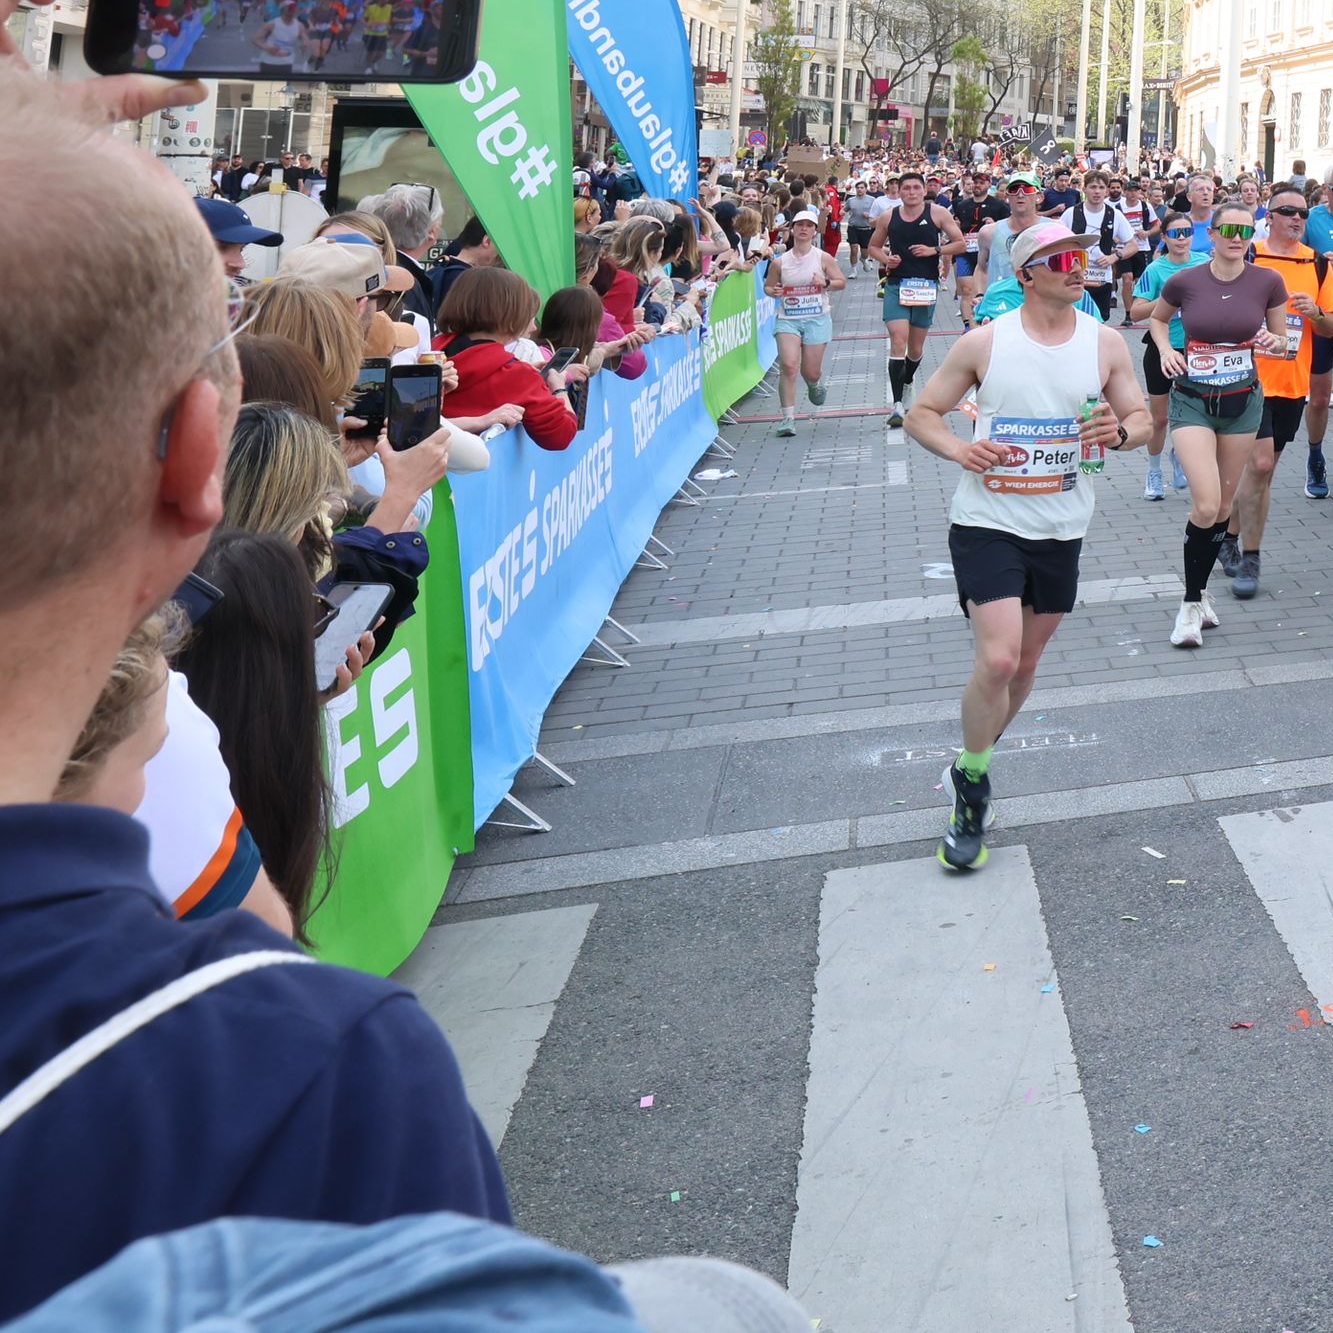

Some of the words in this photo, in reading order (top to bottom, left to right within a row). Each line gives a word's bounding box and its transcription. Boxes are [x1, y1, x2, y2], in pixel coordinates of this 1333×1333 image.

[801, 297, 819, 305] Julia
[1223, 355, 1243, 367] Eva
[994, 423, 1068, 436] SPARKASSE
[1032, 449, 1076, 466] Peter
[1004, 481, 1026, 489] WIEN
[1028, 480, 1059, 489] ENERGIE
[469, 523, 522, 673] ERSTE
[541, 436, 606, 576] SPARKASSE
